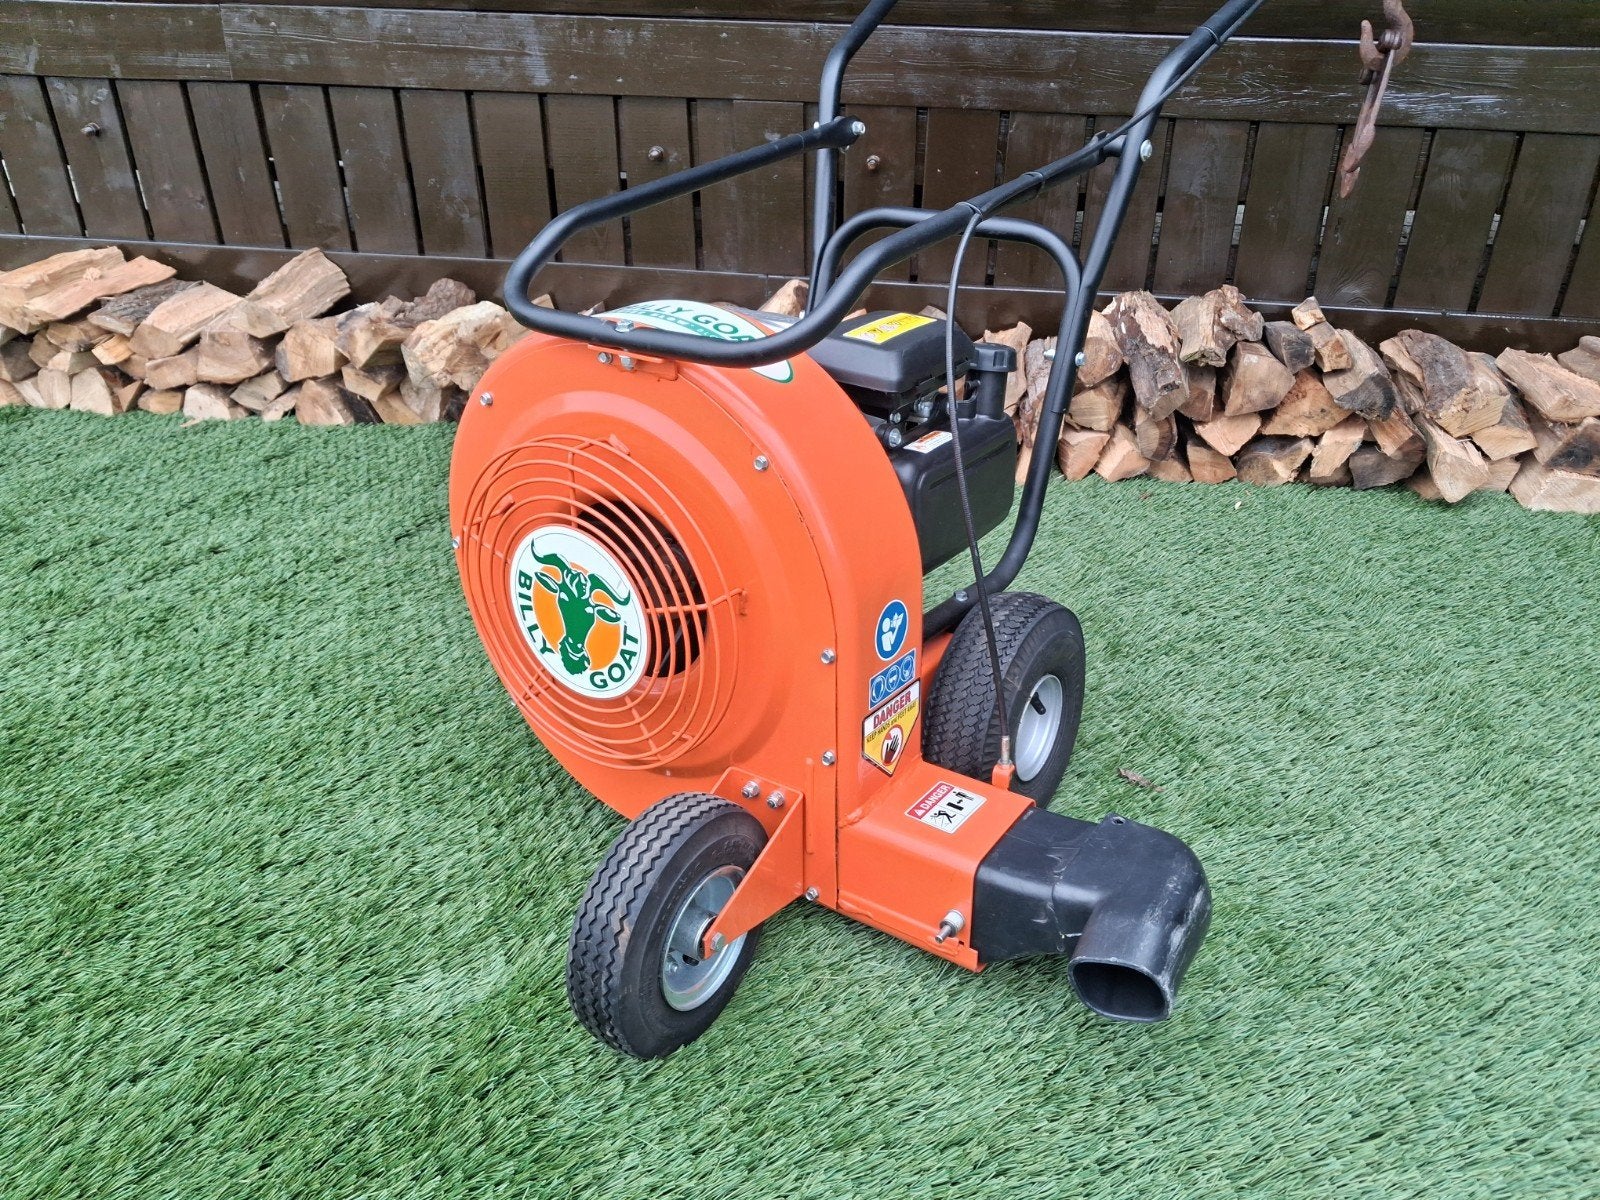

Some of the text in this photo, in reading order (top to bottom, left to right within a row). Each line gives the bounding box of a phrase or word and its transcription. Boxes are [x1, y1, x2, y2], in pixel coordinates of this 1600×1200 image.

[518, 570, 639, 689] BILLY GOAT
[873, 690, 911, 729] DANGER
[866, 731, 877, 743] KEEP
[919, 784, 951, 810] DANGER
